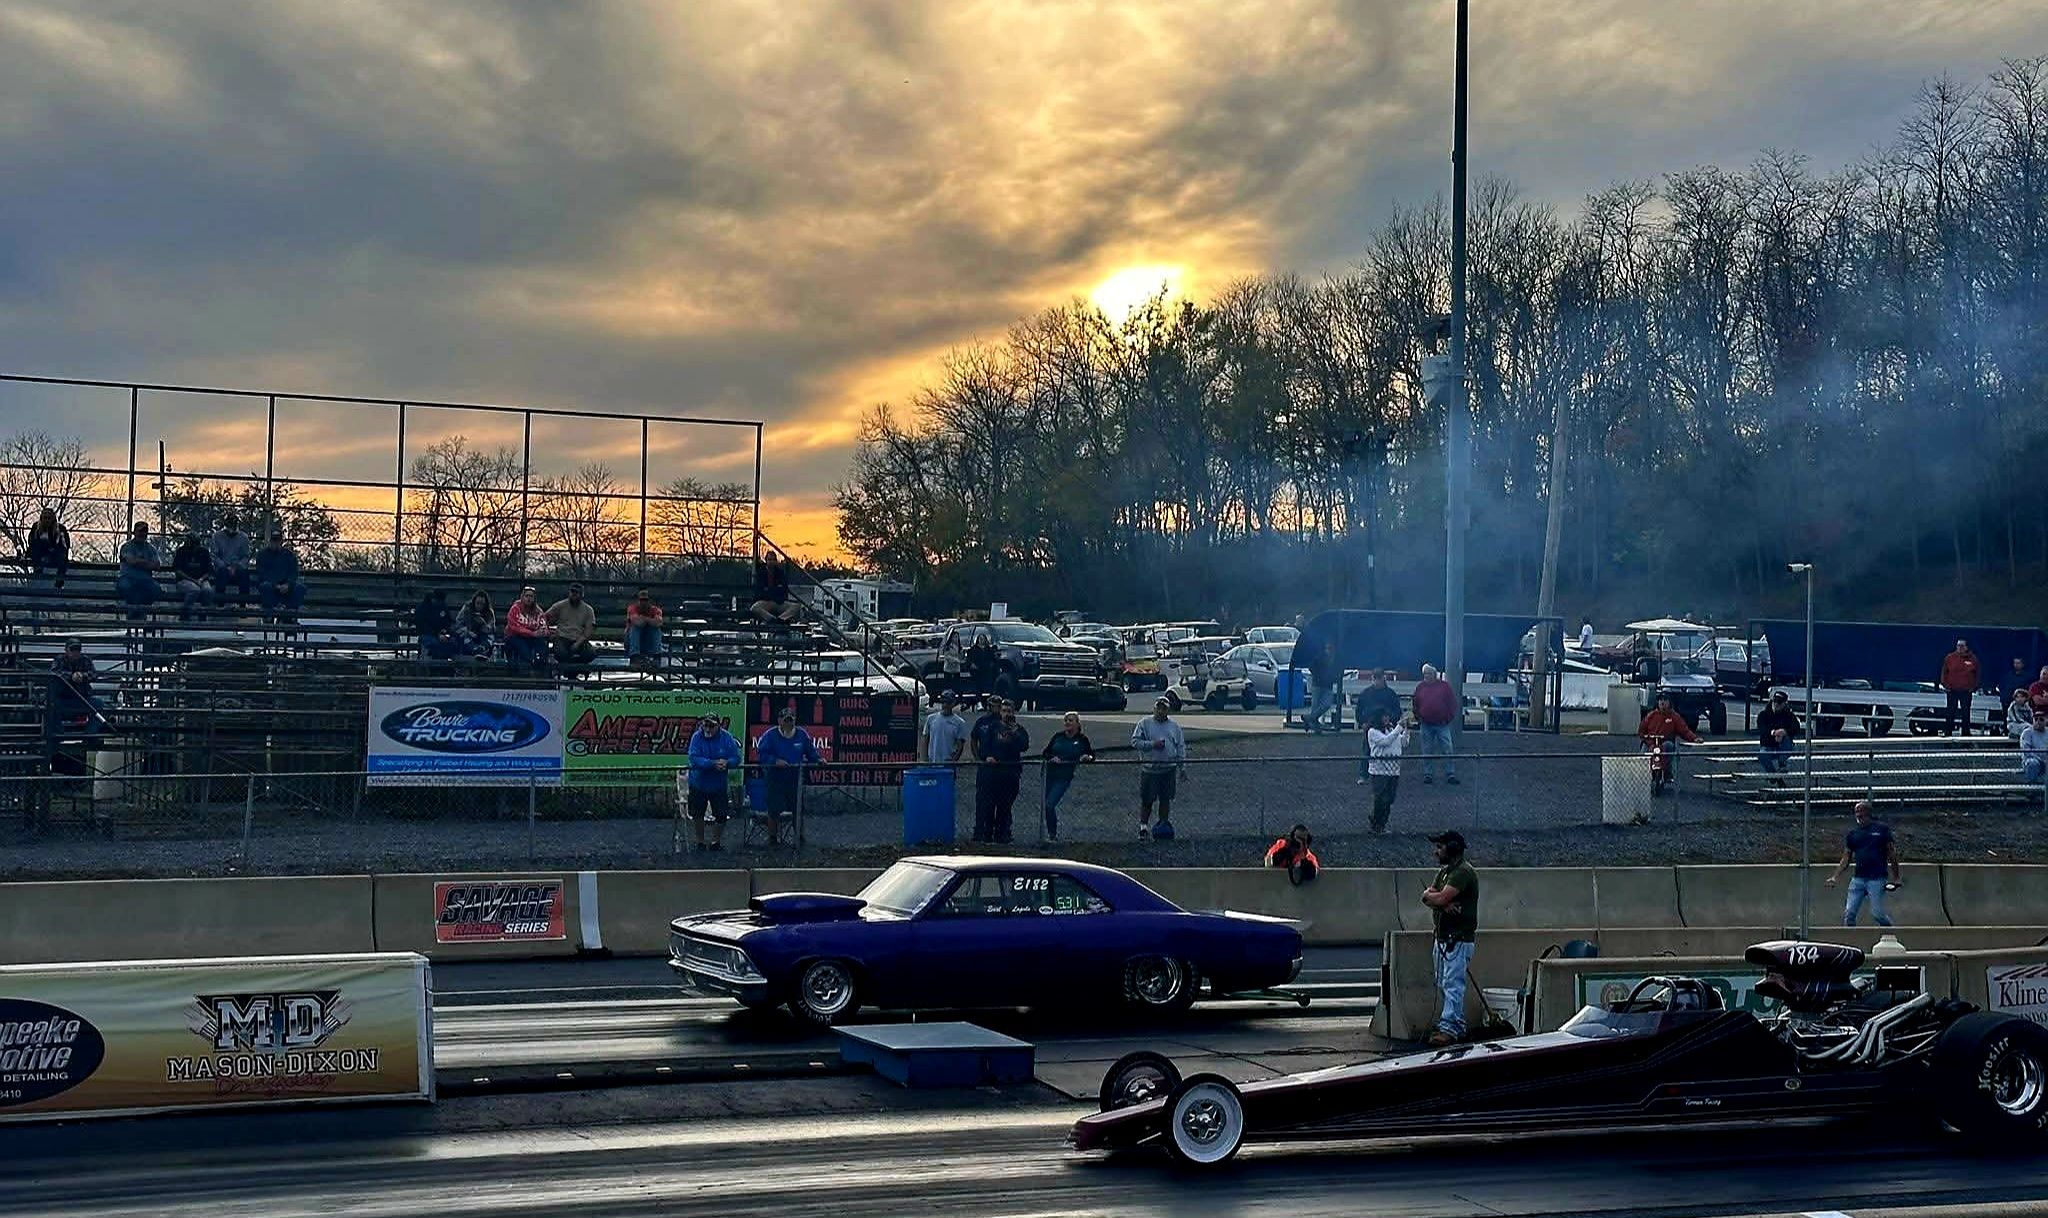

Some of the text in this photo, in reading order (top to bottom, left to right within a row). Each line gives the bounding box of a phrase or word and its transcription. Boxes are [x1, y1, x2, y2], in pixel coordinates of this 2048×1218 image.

[572, 694, 741, 705] PROUD TRACK SPONSOR
[405, 706, 470, 728] Bowie
[567, 708, 731, 739] AMERITE
[840, 716, 873, 727] AMMO
[399, 729, 520, 743] TRUCKING
[840, 734, 888, 745] TRAINING
[882, 752, 916, 763] RANGE
[809, 770, 847, 783] WEST
[851, 769, 870, 783] ON
[874, 770, 889, 783] RT
[1013, 877, 1049, 891] E182
[439, 884, 562, 925] SAVAGE
[453, 921, 550, 936] RACING SERIES
[0, 1015, 81, 1049] peake
[0, 1044, 73, 1071] otive
[168, 1049, 379, 1081] MASON-DIXON
[3, 1071, 69, 1082] DETAILING
